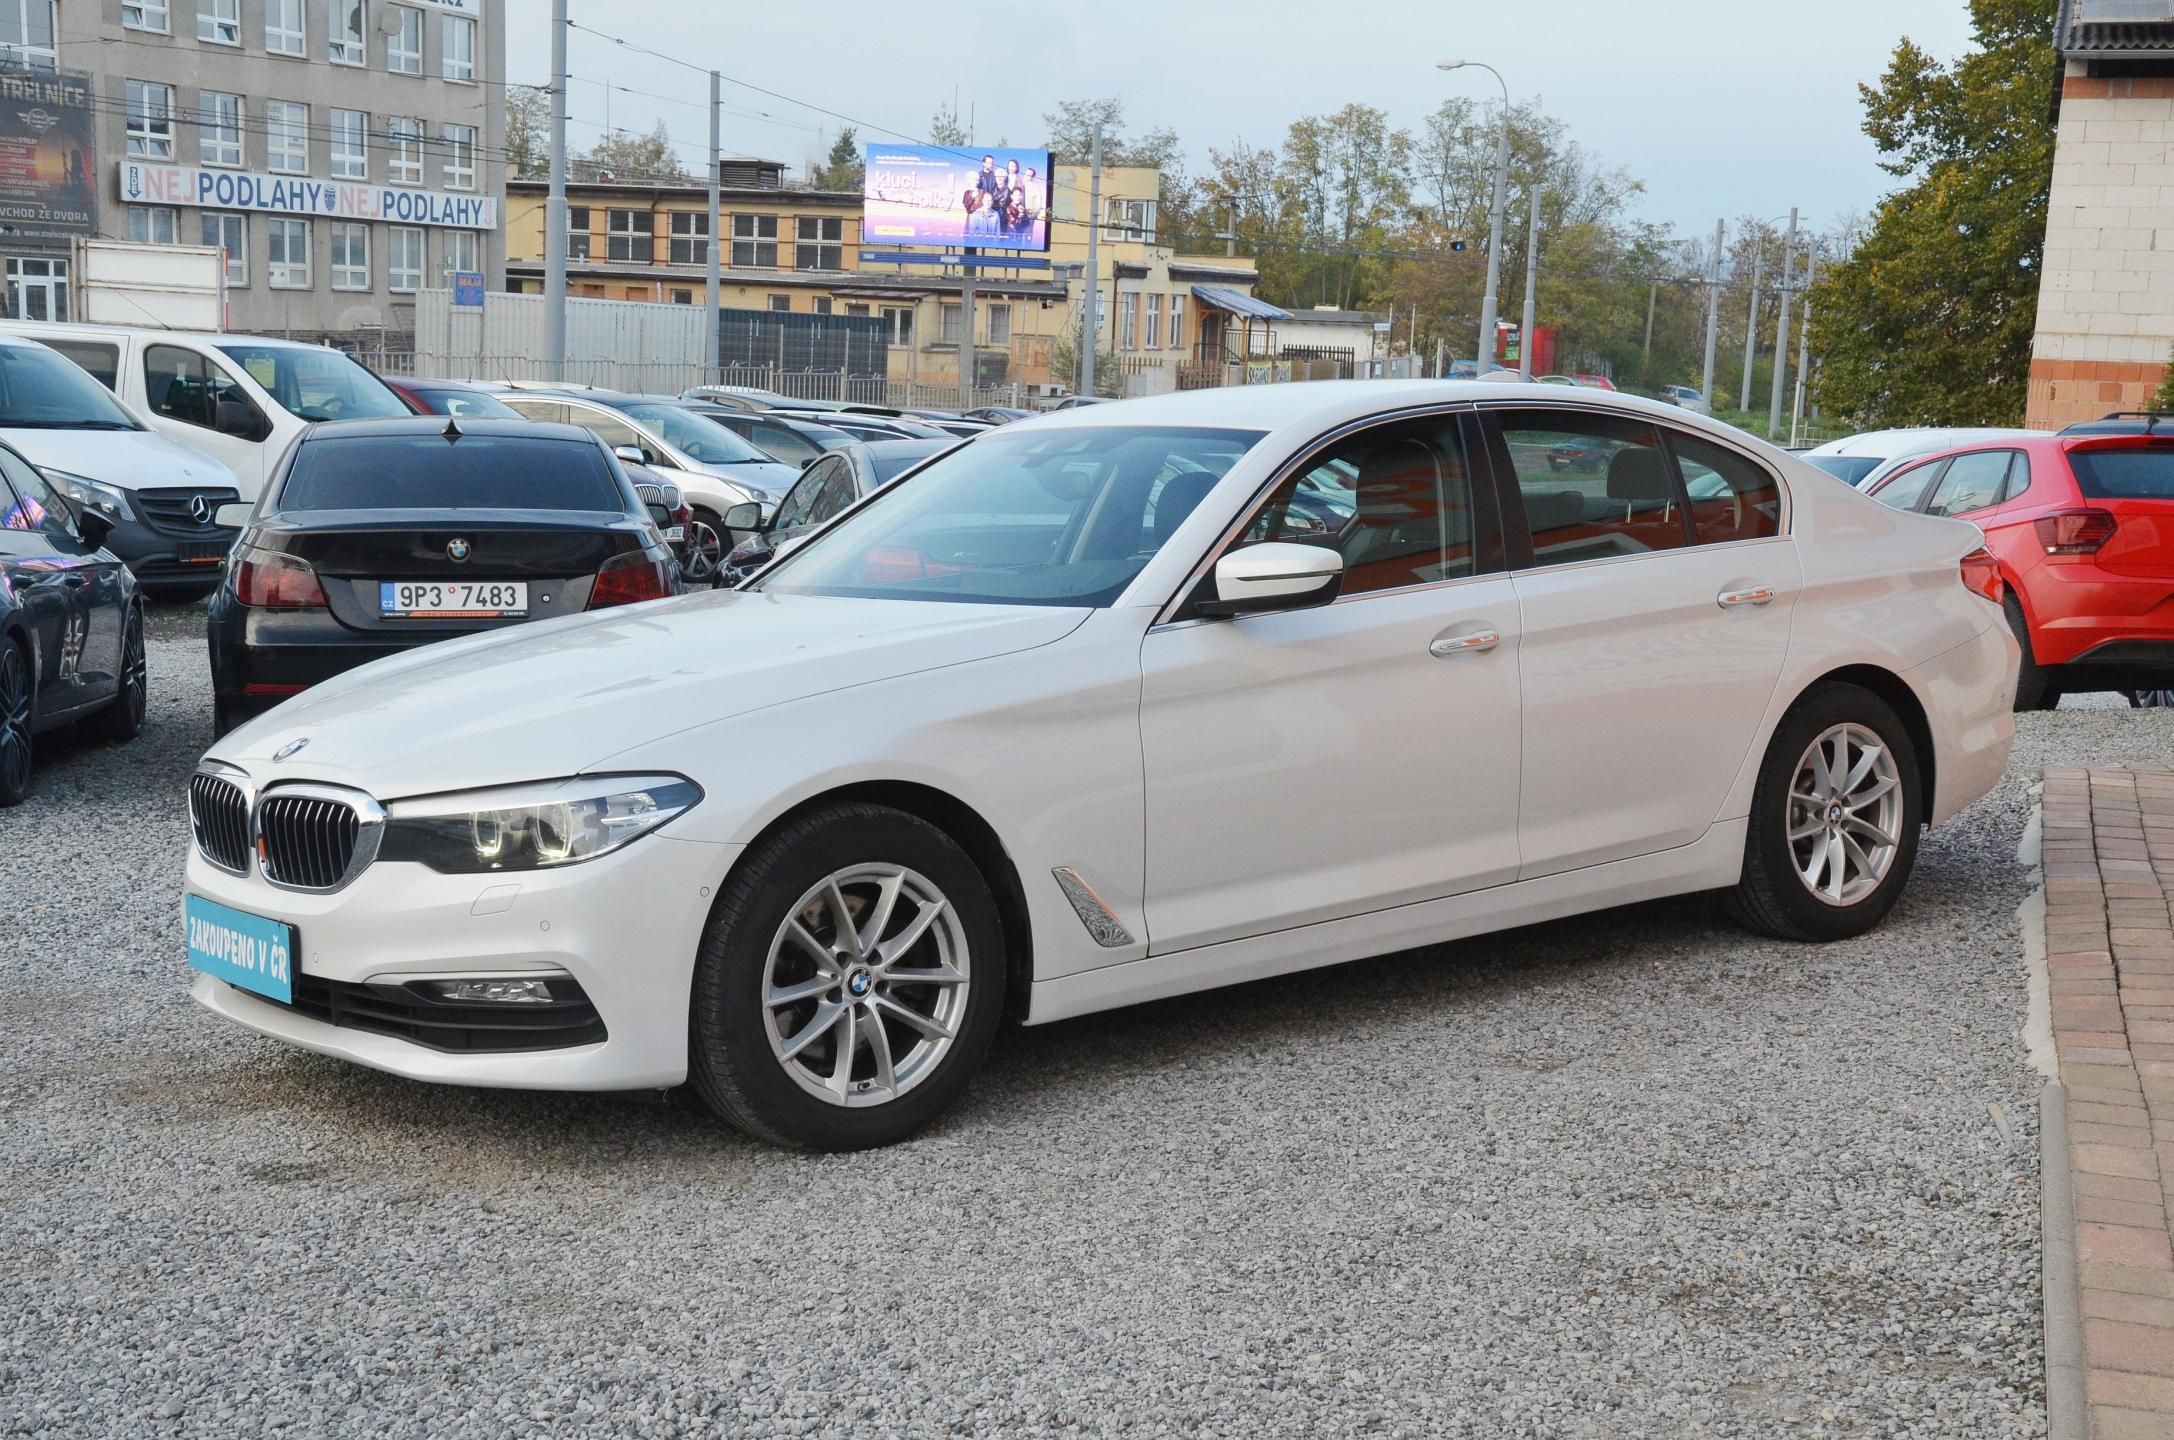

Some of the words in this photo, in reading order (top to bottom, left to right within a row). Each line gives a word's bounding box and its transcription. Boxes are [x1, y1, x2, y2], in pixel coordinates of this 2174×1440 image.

[0, 207, 35, 217] VCHOD
[38, 209, 51, 219] ZE
[54, 211, 88, 221] DVORA
[400, 586, 442, 608] 9P3
[460, 586, 517, 608] 7483
[190, 917, 255, 970] ZAKOUPENO
[258, 940, 267, 974] V
[270, 935, 288, 984] ČR
